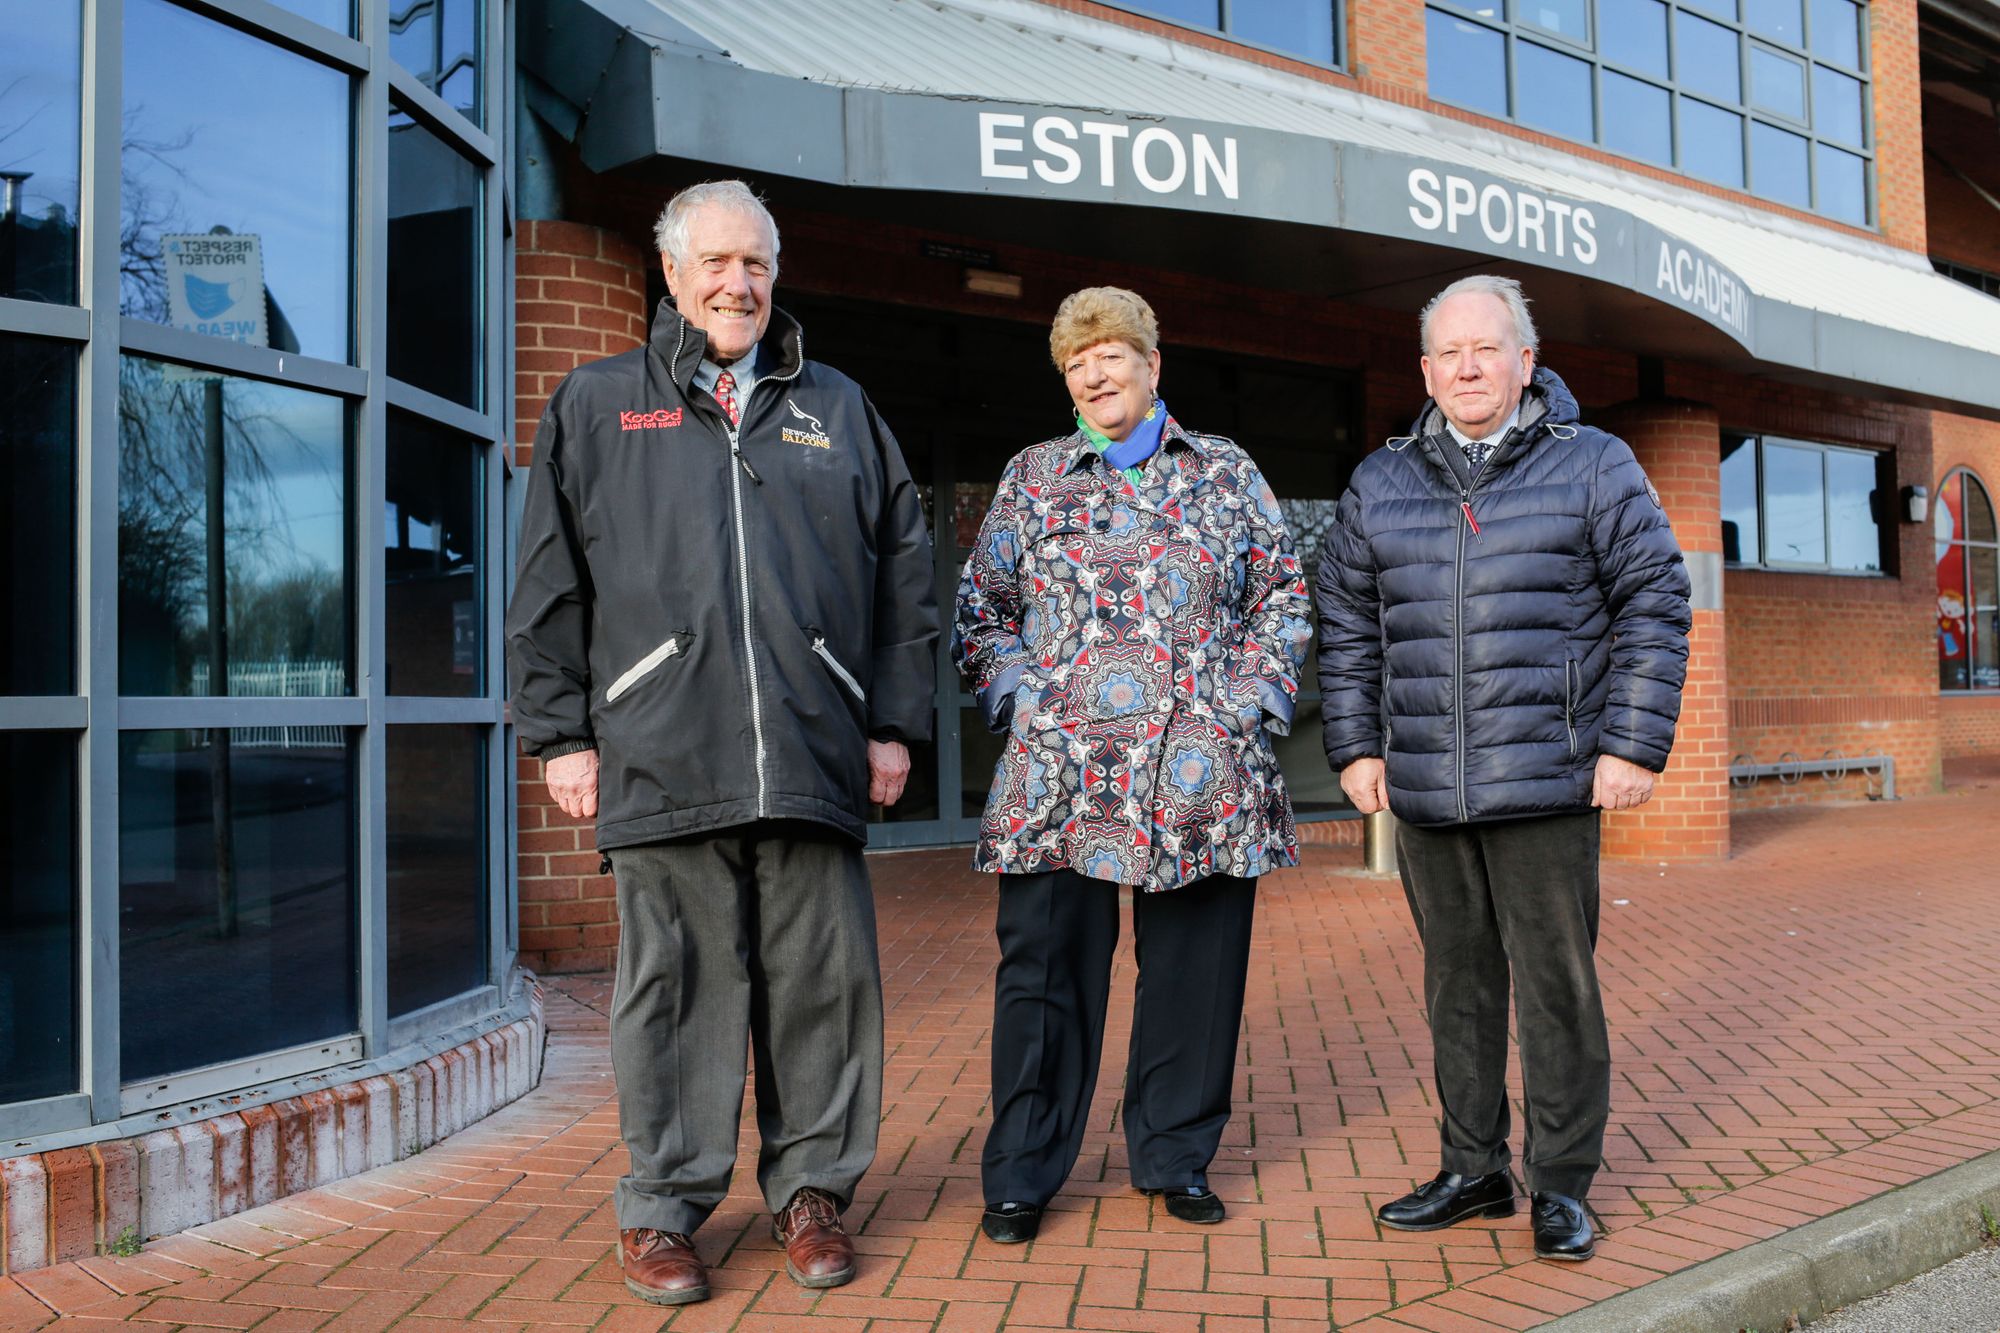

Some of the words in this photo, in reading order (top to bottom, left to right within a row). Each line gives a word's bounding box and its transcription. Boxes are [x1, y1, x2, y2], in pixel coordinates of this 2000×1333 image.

[979, 112, 1239, 200] ESTON
[1408, 168, 1598, 265] SPORTS
[1656, 241, 1750, 338] ACADEMY
[622, 422, 642, 431] MADE
[643, 421, 657, 429] FOR
[658, 420, 682, 429] RUGBY
[782, 426, 830, 443] NEWCASTLE
[782, 432, 831, 449] FALCONS
